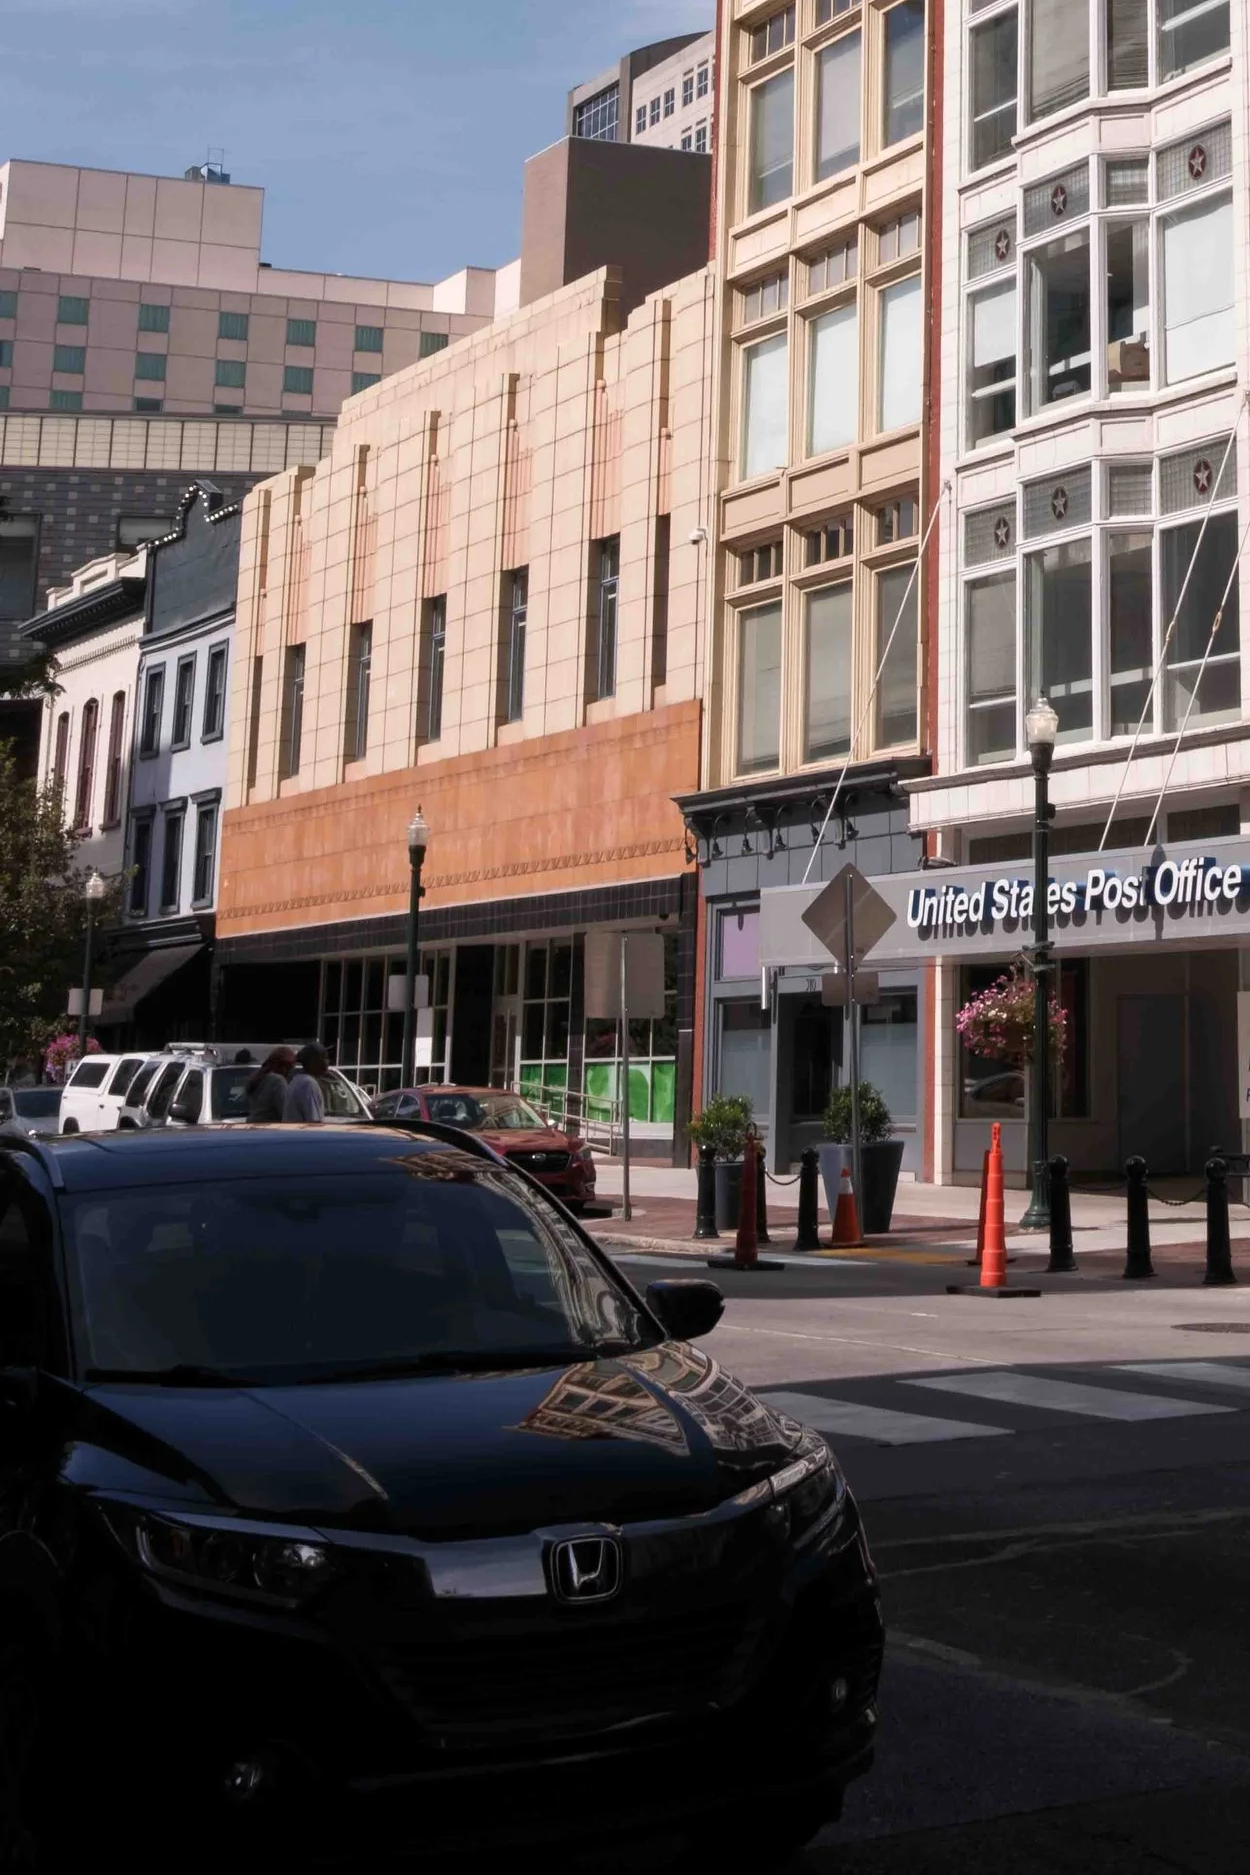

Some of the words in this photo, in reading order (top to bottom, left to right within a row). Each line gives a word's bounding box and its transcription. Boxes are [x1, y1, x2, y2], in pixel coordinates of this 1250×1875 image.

[907, 881, 987, 927] United
[991, 879, 1078, 921] Staes
[1153, 856, 1243, 906] Office
